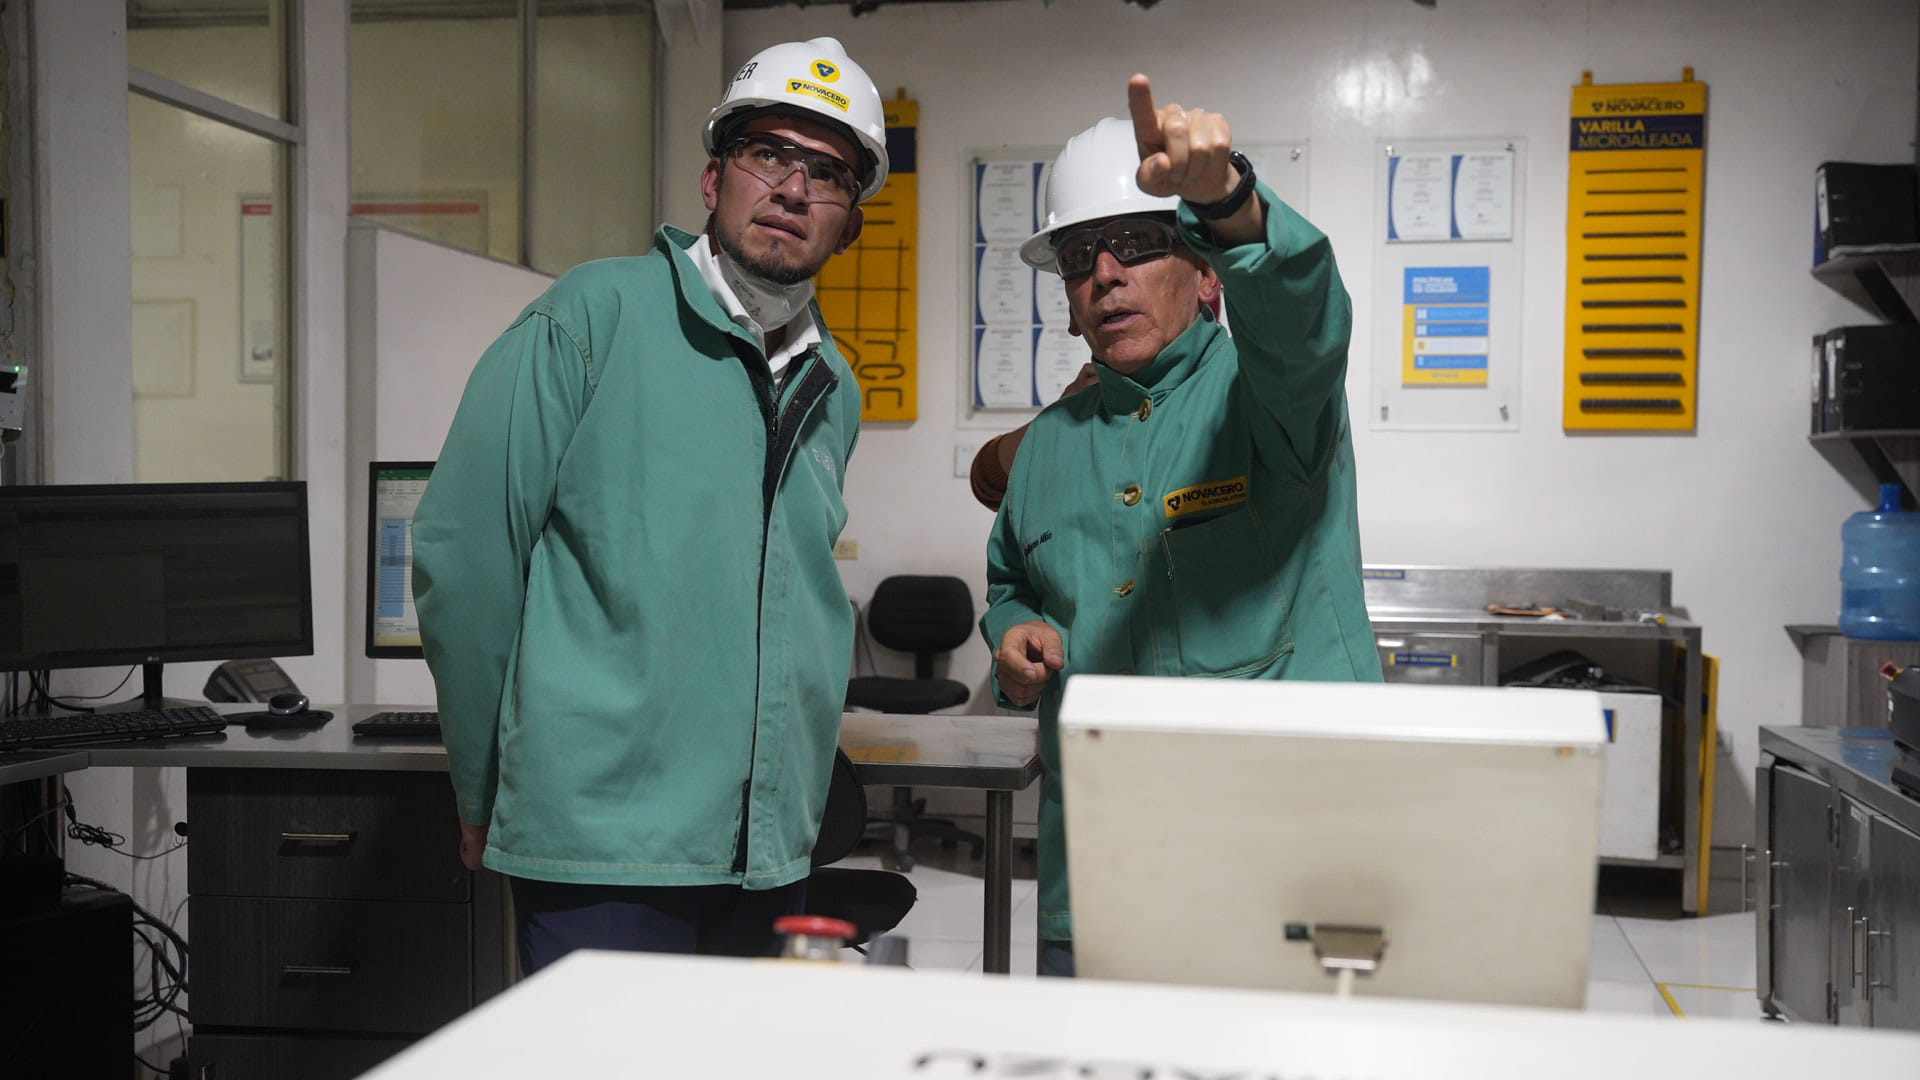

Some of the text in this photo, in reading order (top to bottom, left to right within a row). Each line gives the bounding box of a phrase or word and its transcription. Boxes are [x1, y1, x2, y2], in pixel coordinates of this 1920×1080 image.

[802, 83, 847, 105] NOVACERO
[1606, 100, 1685, 112] NOVACERO
[1578, 119, 1646, 133] VARILLA
[1578, 133, 1694, 148] MICROALEADA
[1182, 482, 1244, 503] NOVACERO
